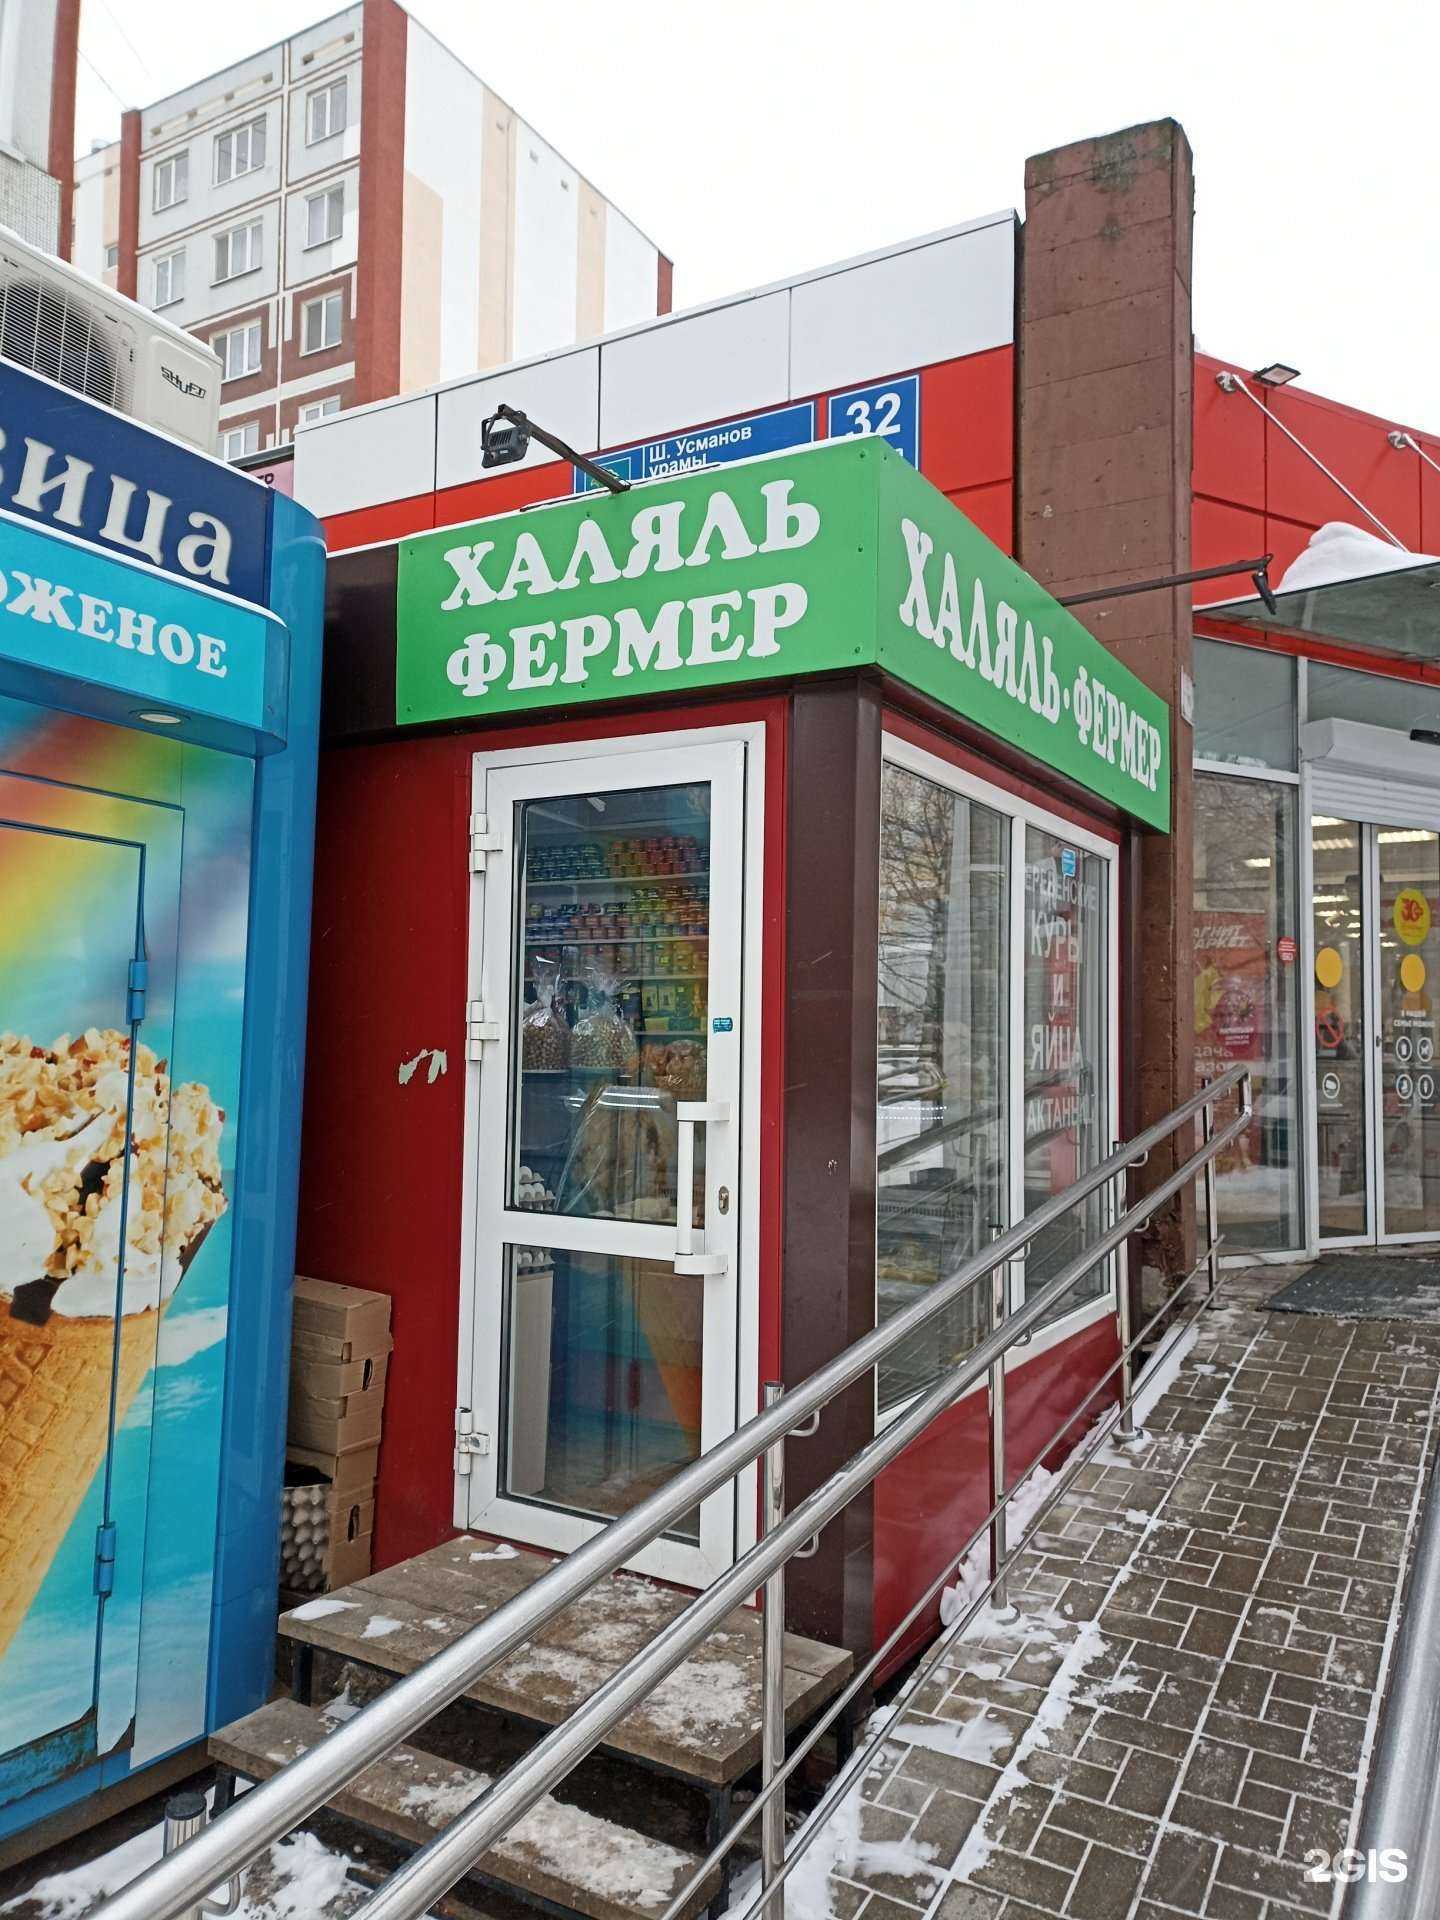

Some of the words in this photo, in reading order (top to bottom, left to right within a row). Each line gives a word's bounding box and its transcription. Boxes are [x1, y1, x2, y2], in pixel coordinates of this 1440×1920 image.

[649, 443, 671, 463] Ш.
[676, 426, 752, 457] Усманов
[846, 392, 901, 436] 32
[0, 427, 232, 585] ица
[441, 479, 821, 611] ХАЛЯЛЬ
[0, 569, 228, 679] ЖЕНОЕ
[446, 583, 808, 697] ФЕРМЕР
